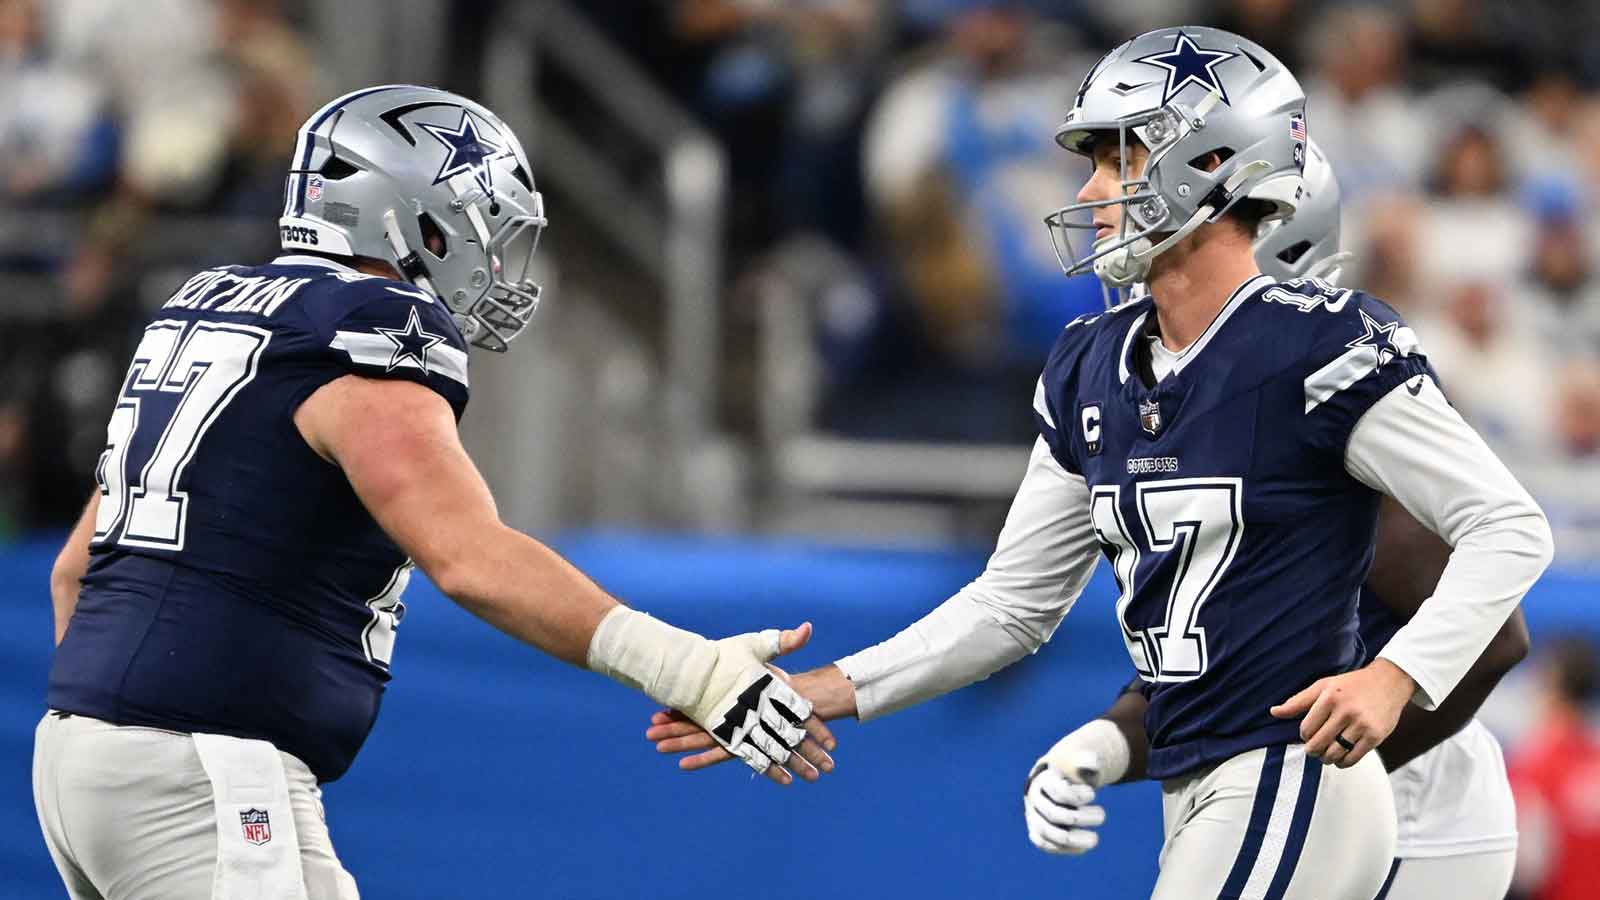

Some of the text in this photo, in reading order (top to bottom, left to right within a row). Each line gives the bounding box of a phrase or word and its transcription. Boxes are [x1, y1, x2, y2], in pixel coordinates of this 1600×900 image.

[92, 319, 273, 551] 67
[1082, 405, 1101, 443] C
[1127, 457, 1178, 474] COWBOYS
[1090, 477, 1245, 683] 17
[245, 824, 269, 841] NFL
